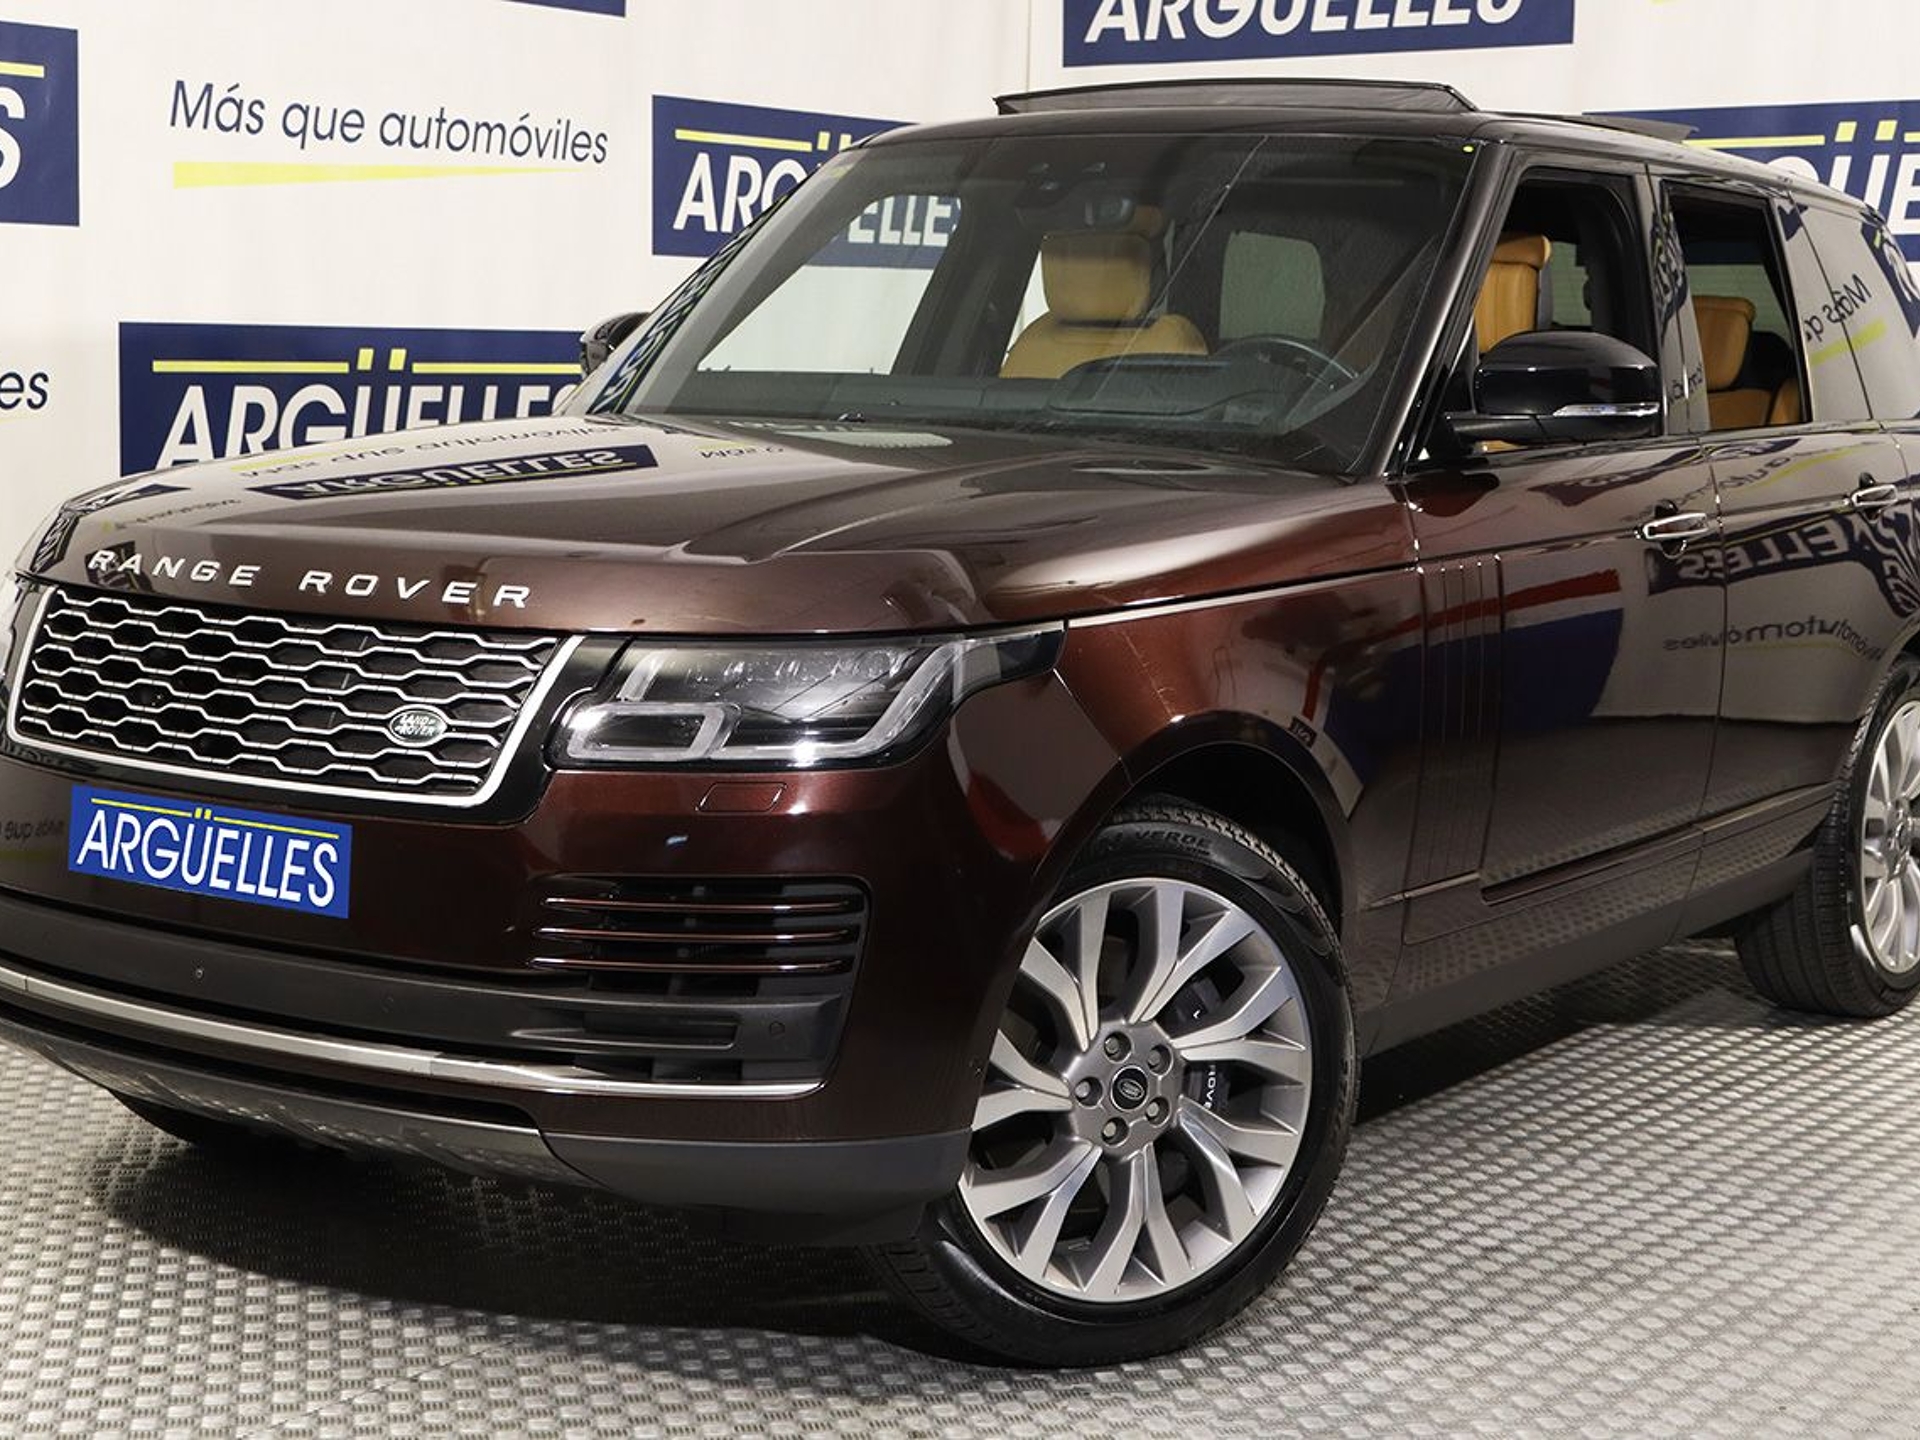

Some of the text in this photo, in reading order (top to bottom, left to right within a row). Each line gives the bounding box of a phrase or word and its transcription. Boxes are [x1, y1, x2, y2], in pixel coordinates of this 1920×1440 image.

[170, 80, 608, 163] Más que automóviles
[155, 348, 580, 470] ARGÜE
[88, 550, 530, 608] RANGE ROVER
[76, 808, 338, 907] ARGÜELLES
